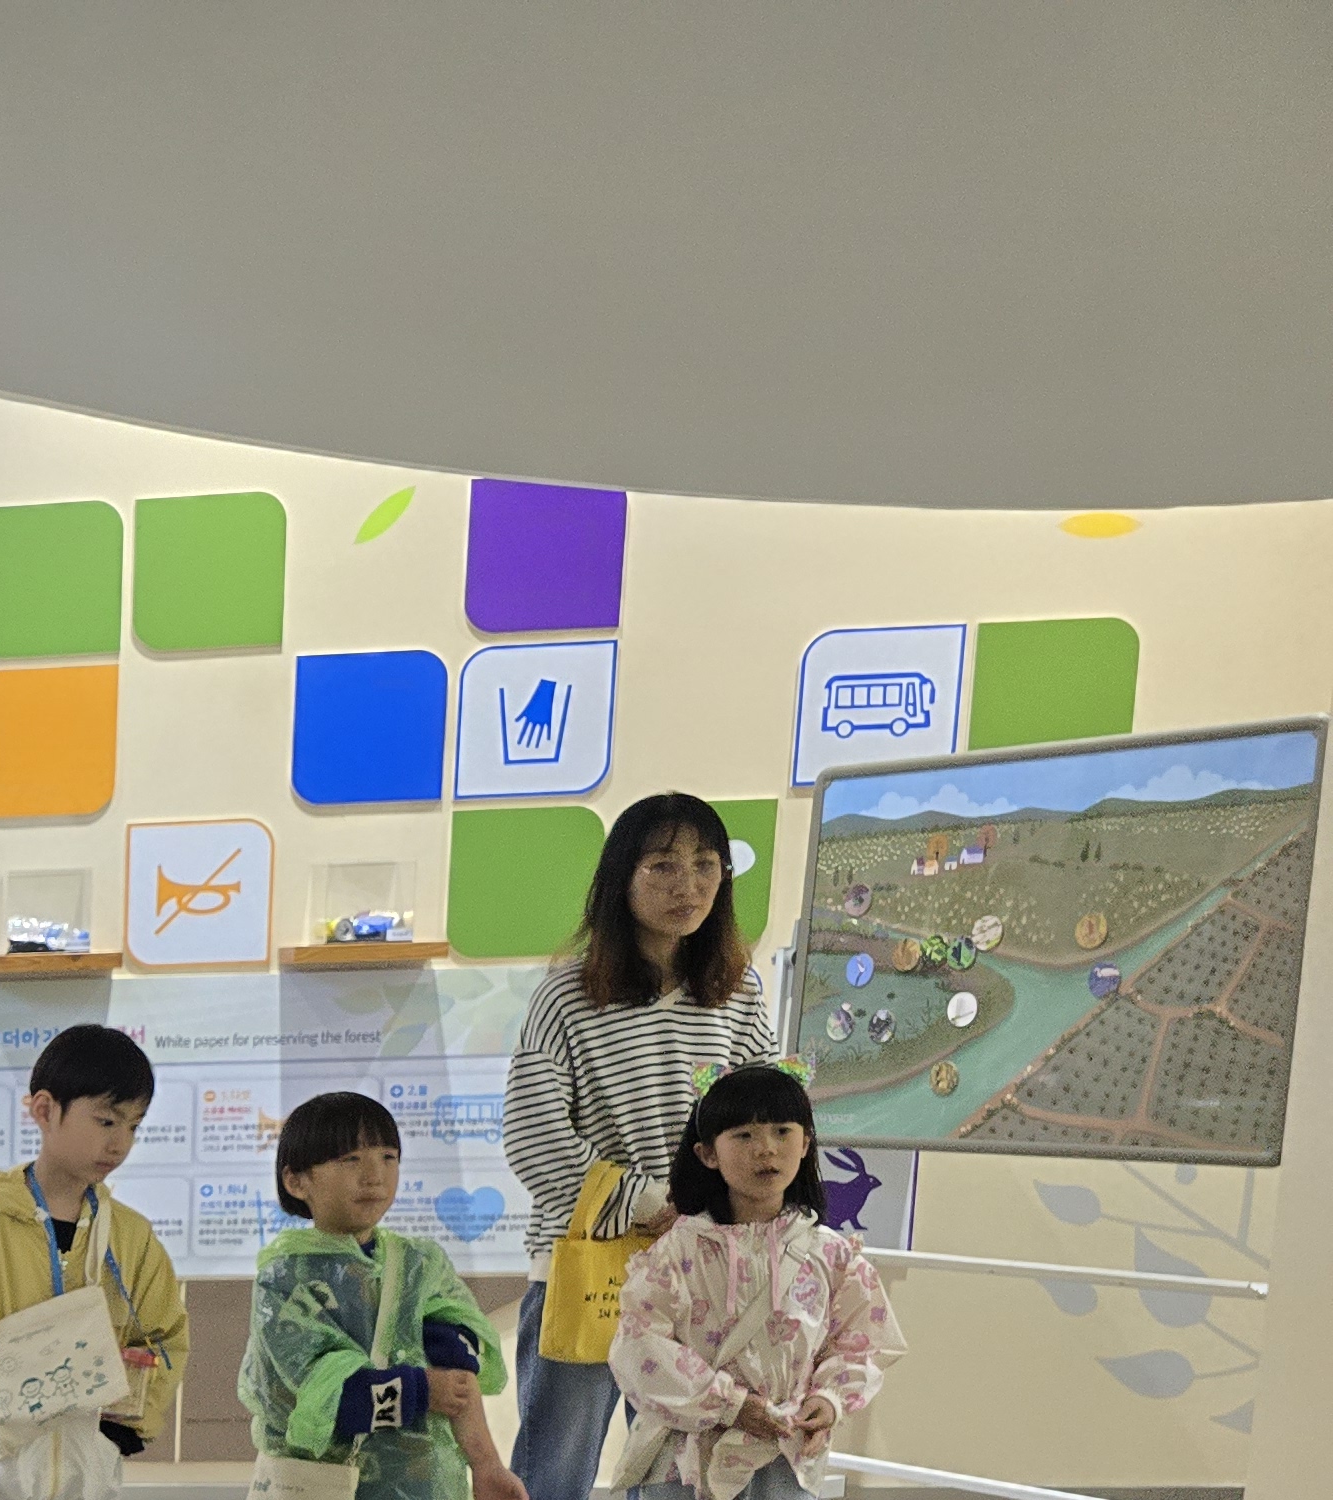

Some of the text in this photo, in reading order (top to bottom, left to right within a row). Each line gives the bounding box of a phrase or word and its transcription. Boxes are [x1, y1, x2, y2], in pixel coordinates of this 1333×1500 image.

[154, 1028, 382, 1050] White paper for preserving the forest
